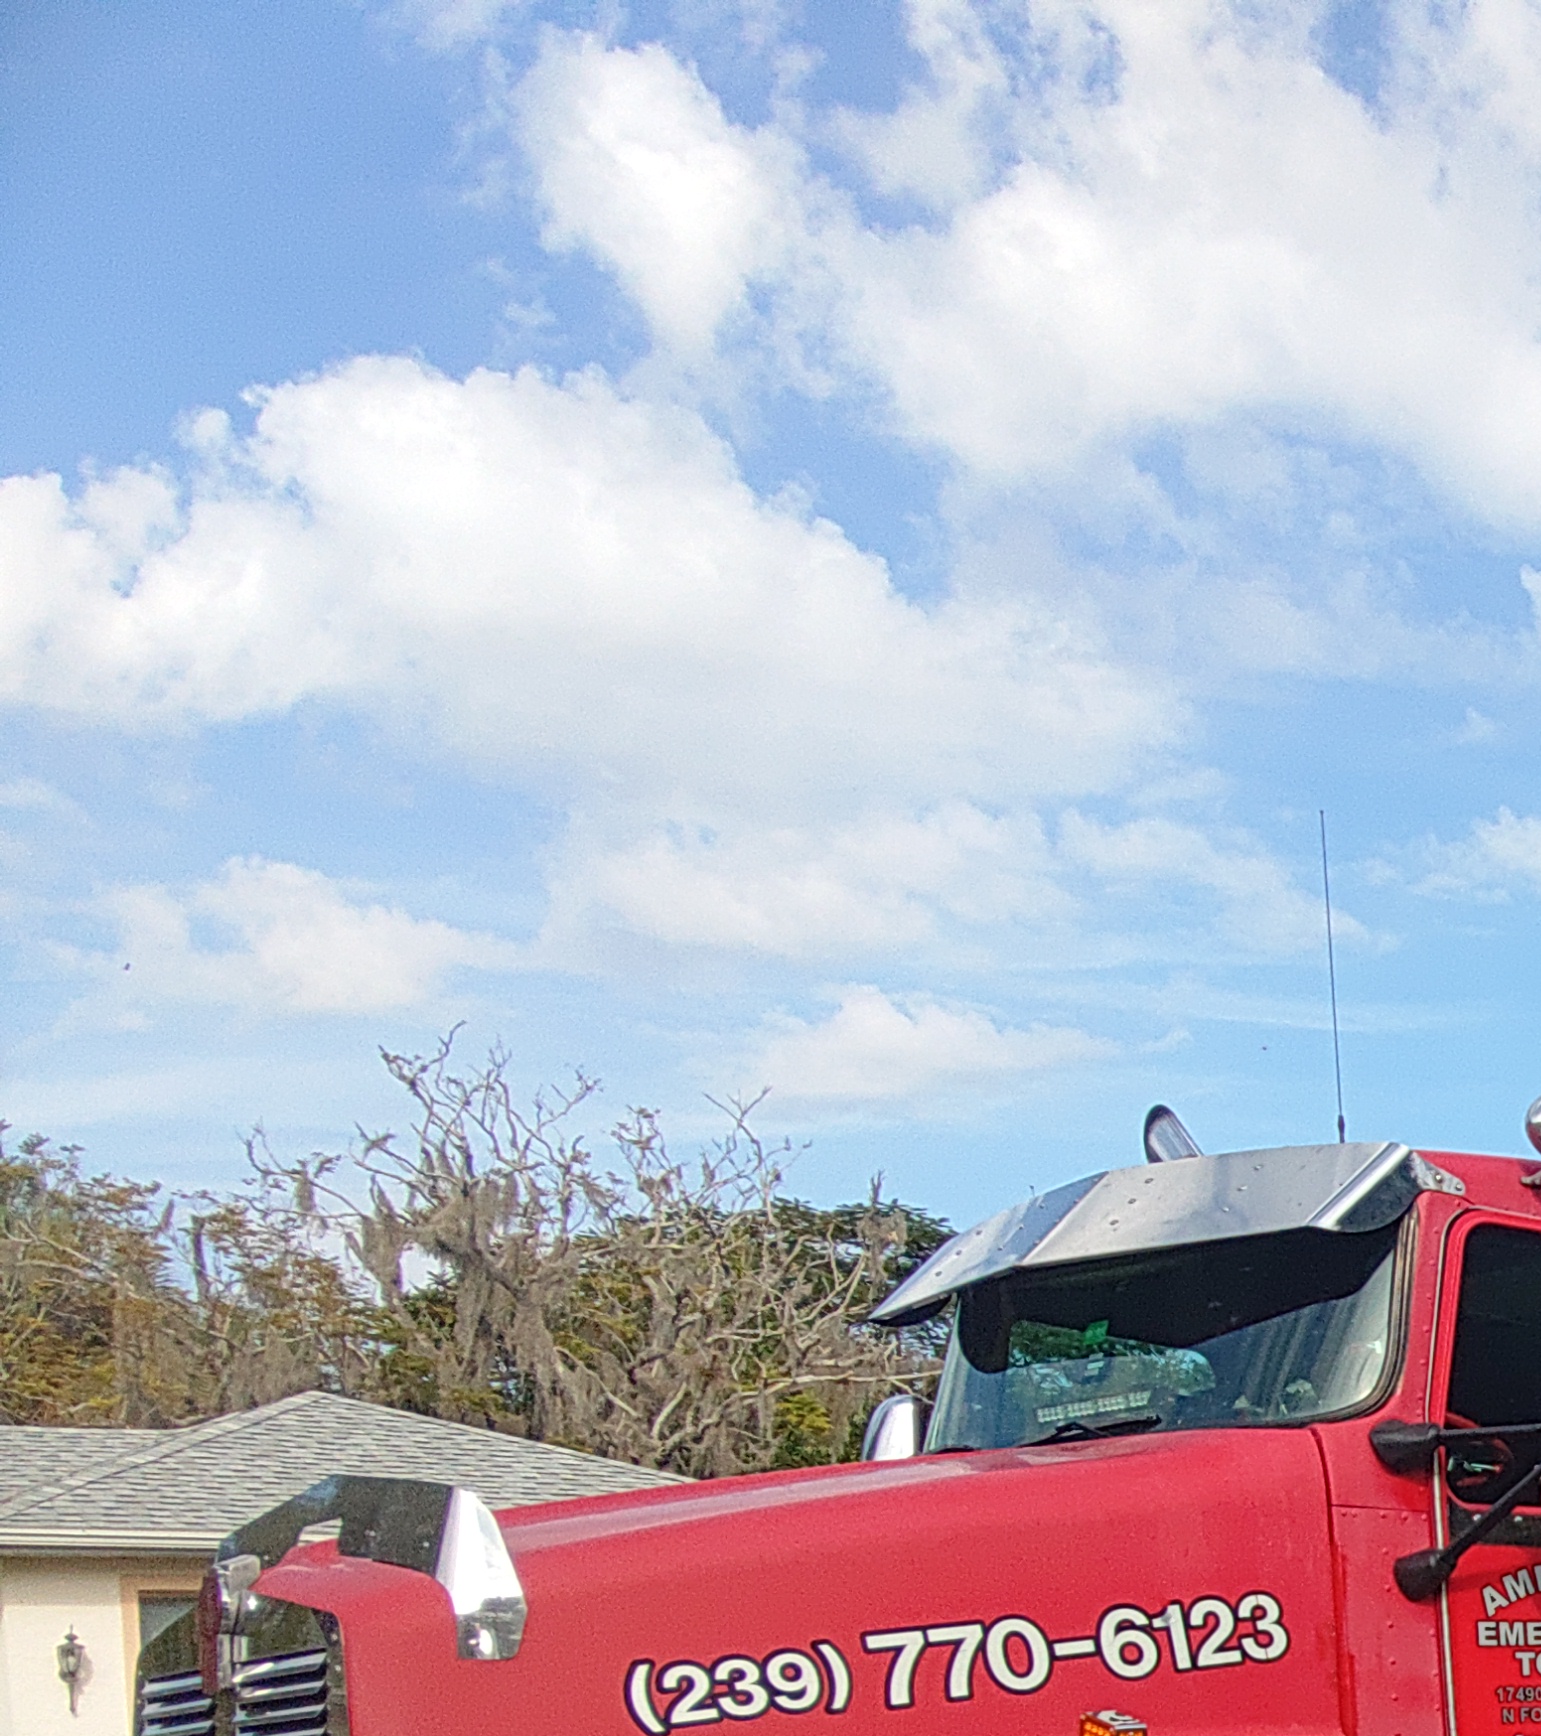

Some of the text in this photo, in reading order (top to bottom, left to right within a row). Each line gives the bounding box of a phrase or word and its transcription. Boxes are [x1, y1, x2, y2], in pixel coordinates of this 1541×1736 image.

[626, 1594, 1290, 1736] (239) 770-6123
[1502, 1708, 1516, 1723] N
